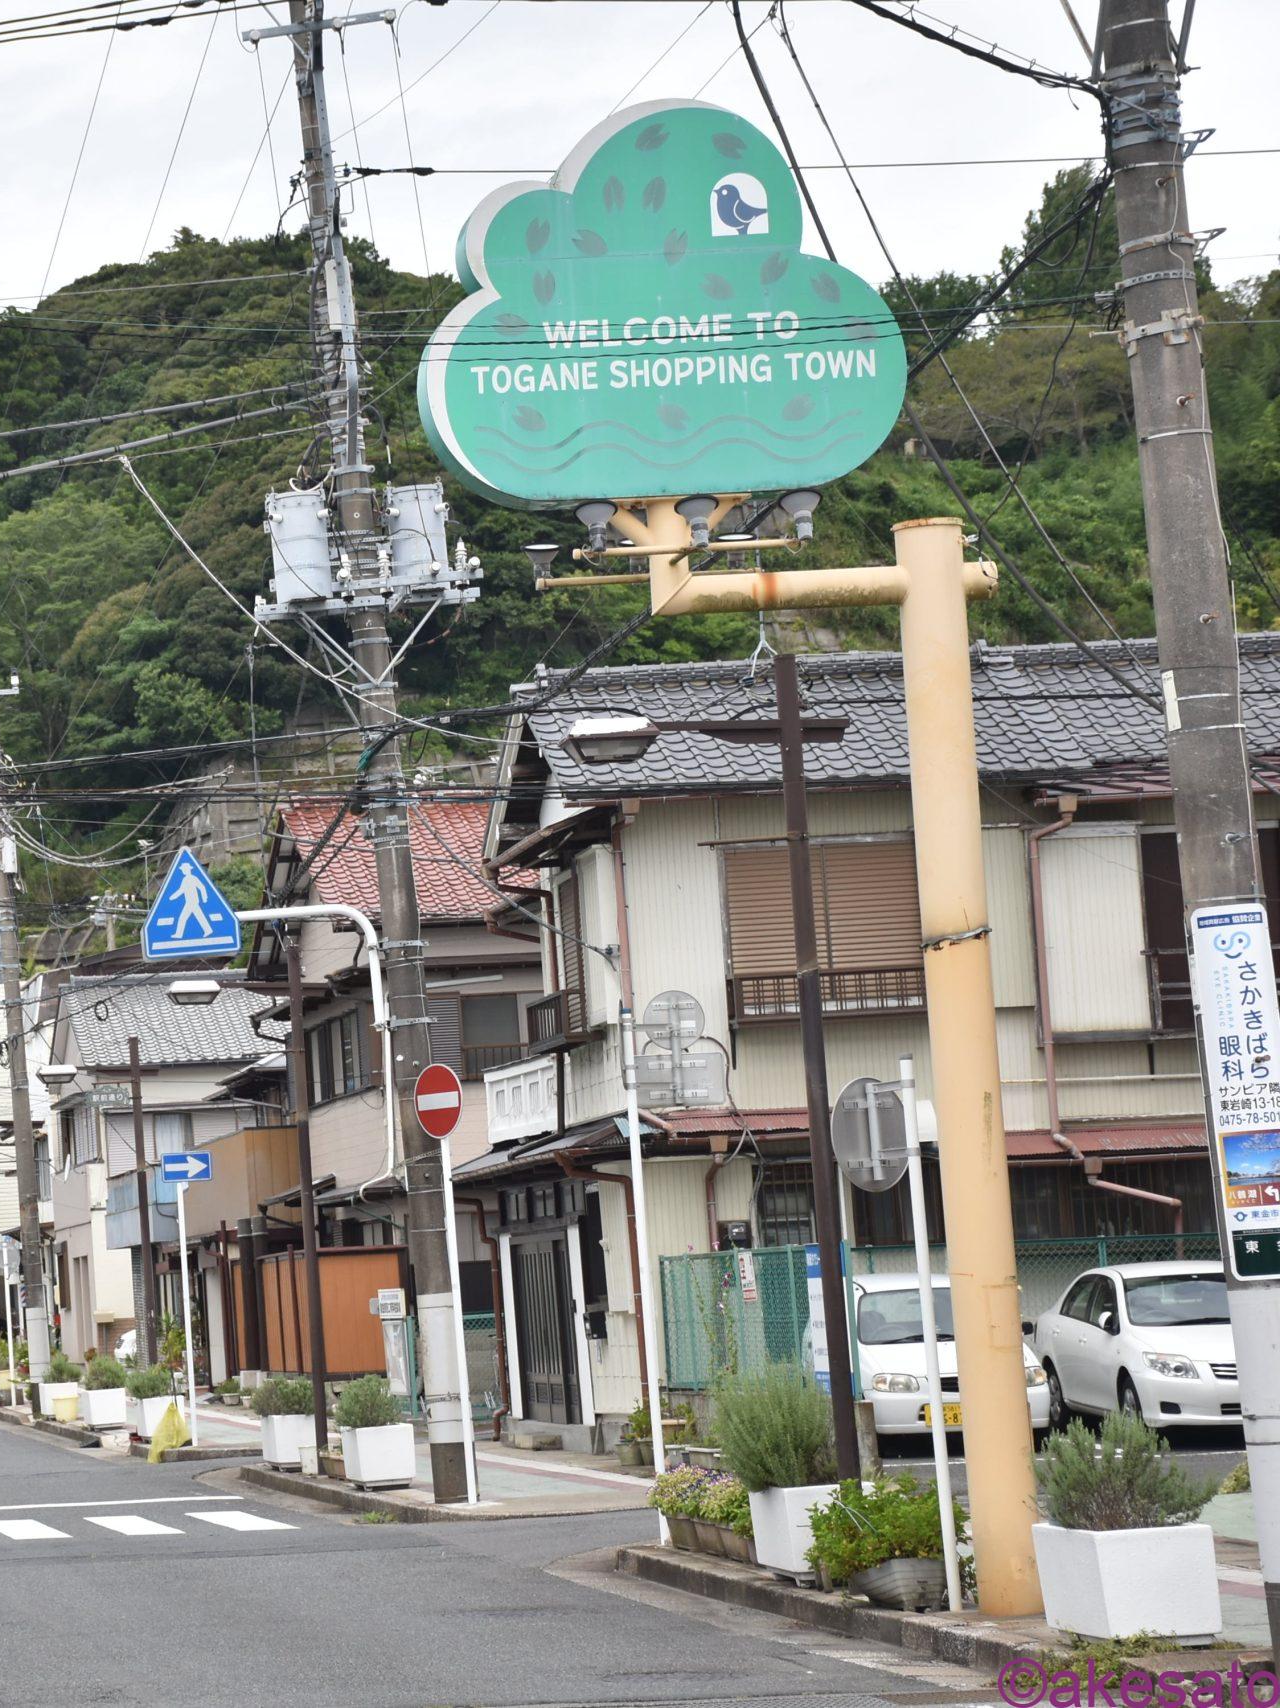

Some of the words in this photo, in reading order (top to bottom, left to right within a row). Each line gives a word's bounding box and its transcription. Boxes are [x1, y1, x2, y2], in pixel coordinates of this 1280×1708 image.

[543, 312, 732, 350] WELCOME
[747, 311, 800, 341] TO
[470, 361, 598, 395] TOGANE
[609, 353, 773, 389] SHOPPING
[784, 349, 877, 381] TOWN
[1214, 971, 1222, 988] EYE
[1238, 961, 1270, 1079] さかきばら
[1219, 1035, 1244, 1081] 眼科
